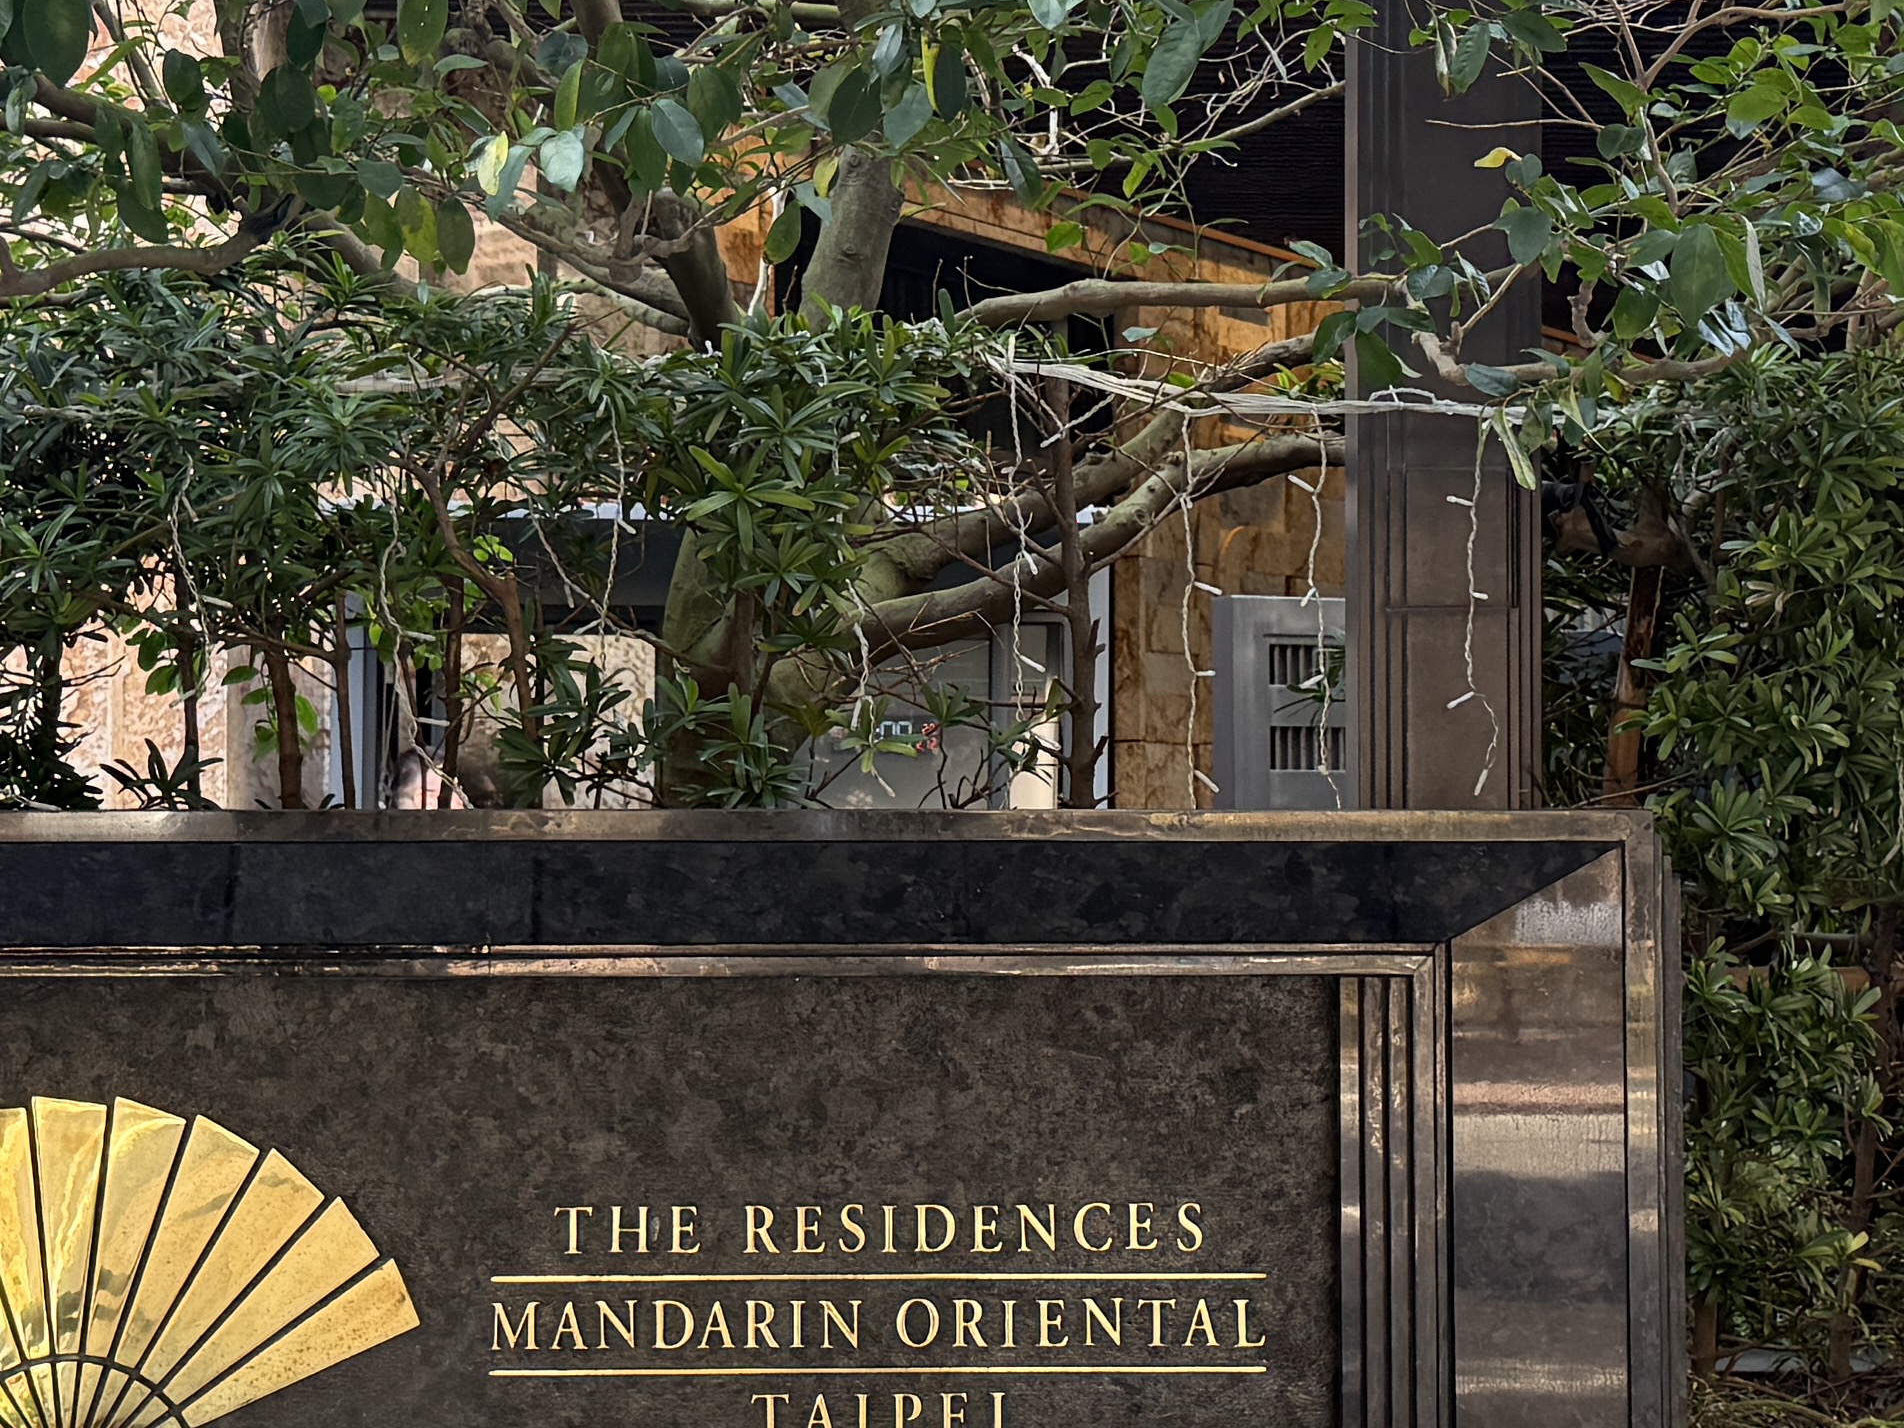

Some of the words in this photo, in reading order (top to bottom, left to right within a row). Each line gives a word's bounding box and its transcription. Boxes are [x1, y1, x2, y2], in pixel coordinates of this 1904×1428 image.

[554, 1205, 700, 1254] THE
[743, 1202, 1204, 1254] RESIDENCES
[491, 1300, 863, 1350] MANDARIN
[896, 1297, 1267, 1348] ORIENTAL
